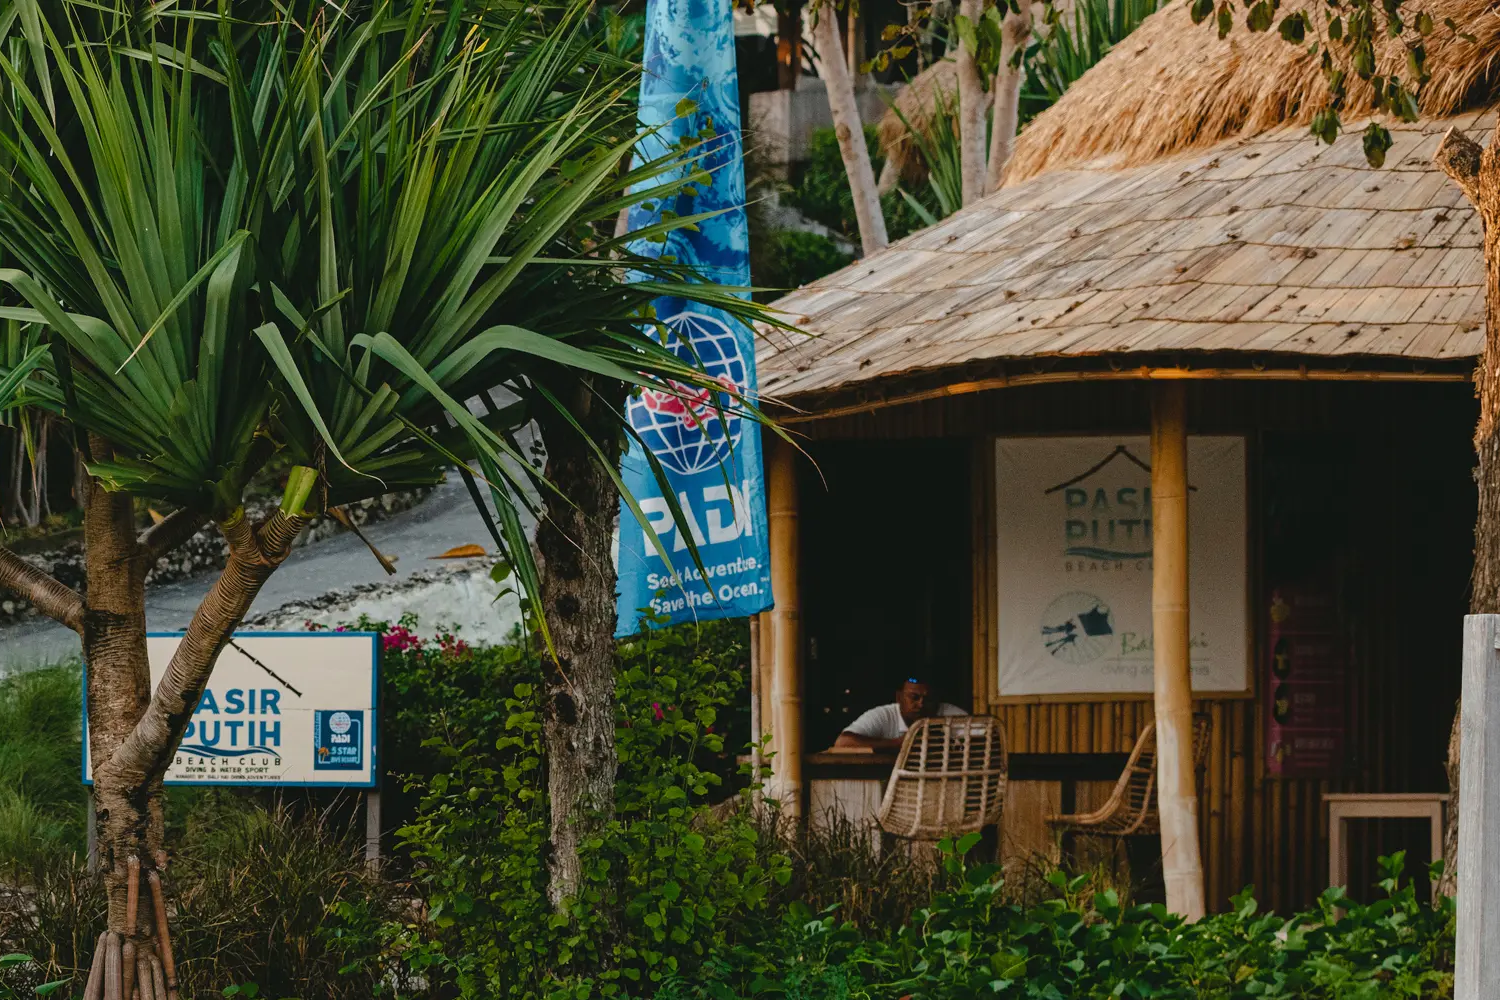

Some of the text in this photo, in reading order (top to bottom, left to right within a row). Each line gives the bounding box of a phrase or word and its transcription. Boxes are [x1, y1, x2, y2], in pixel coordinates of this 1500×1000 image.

[1065, 487, 1153, 514] PASI
[639, 480, 753, 557] PADI
[1065, 519, 1153, 544] PUTI
[1065, 561, 1153, 572] BEACH CL
[649, 597, 685, 616] Save
[686, 590, 714, 608] the
[192, 688, 281, 715] ASIR
[330, 734, 351, 744] PADI
[337, 746, 357, 755] STAR
[176, 757, 281, 766] BEACH CLUB
